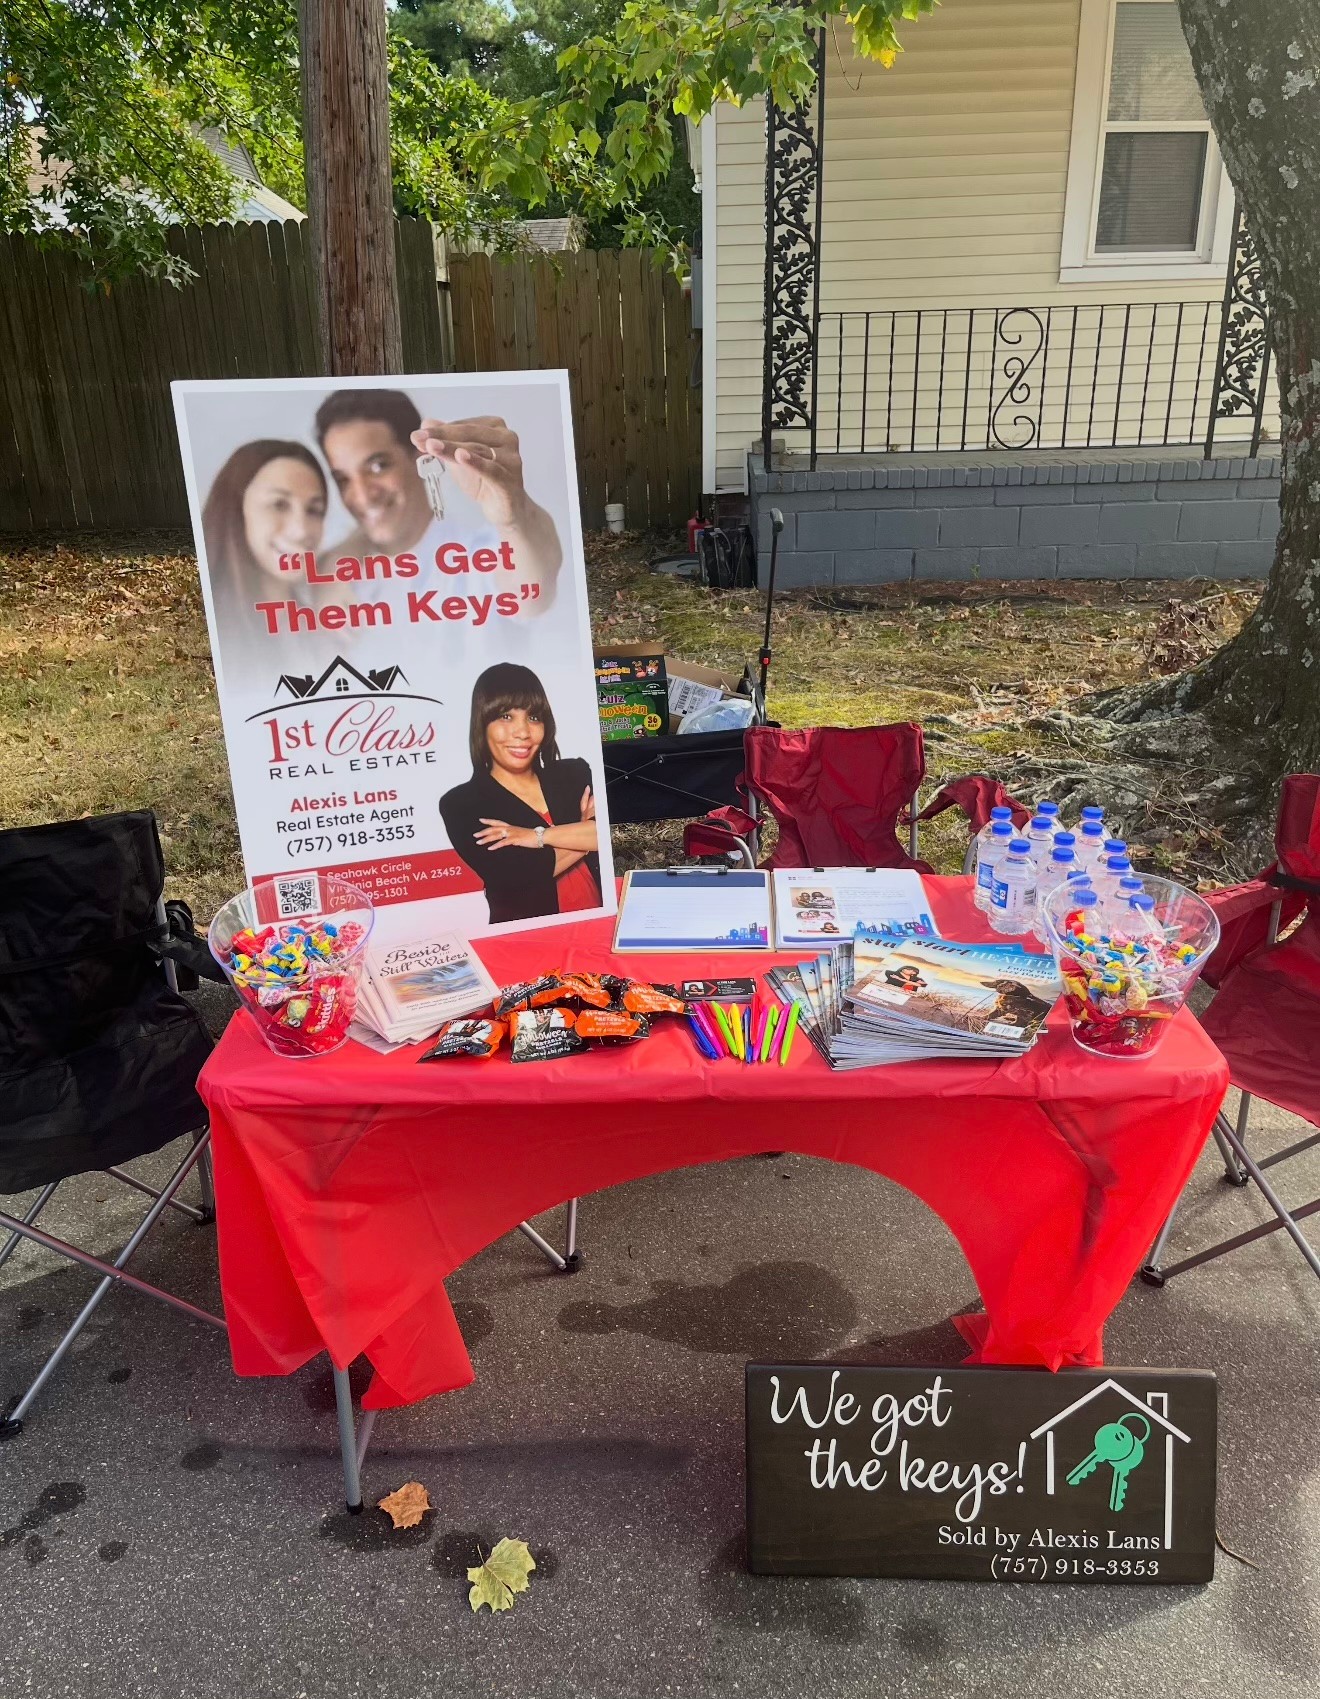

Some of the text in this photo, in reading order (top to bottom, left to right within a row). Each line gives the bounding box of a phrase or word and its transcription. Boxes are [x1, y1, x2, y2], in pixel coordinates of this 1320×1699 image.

[434, 541, 516, 575] Get
[255, 600, 392, 634] Them
[600, 703, 648, 718] lloween
[647, 715, 658, 724] 36
[262, 700, 437, 763] 1st Class
[269, 751, 437, 780] REAL ESTATE
[290, 787, 398, 813] Alexis Lans
[276, 804, 415, 834] Real Estate Agent
[286, 823, 416, 858] (757) 918-3353
[326, 861, 412, 881] Seahawk Circle
[328, 865, 462, 894] Virgnia Beach VA 23452
[329, 886, 409, 908] (757) 95-1301
[379, 951, 469, 977] Still Waters
[384, 943, 450, 965] Beside
[970, 950, 1053, 969] HEALTH
[769, 1370, 953, 1456] We got
[803, 1437, 1028, 1523] the keys!
[938, 1525, 1161, 1552] Sold by Alexis Lans
[990, 1555, 1160, 1580] (757) 918-3353
